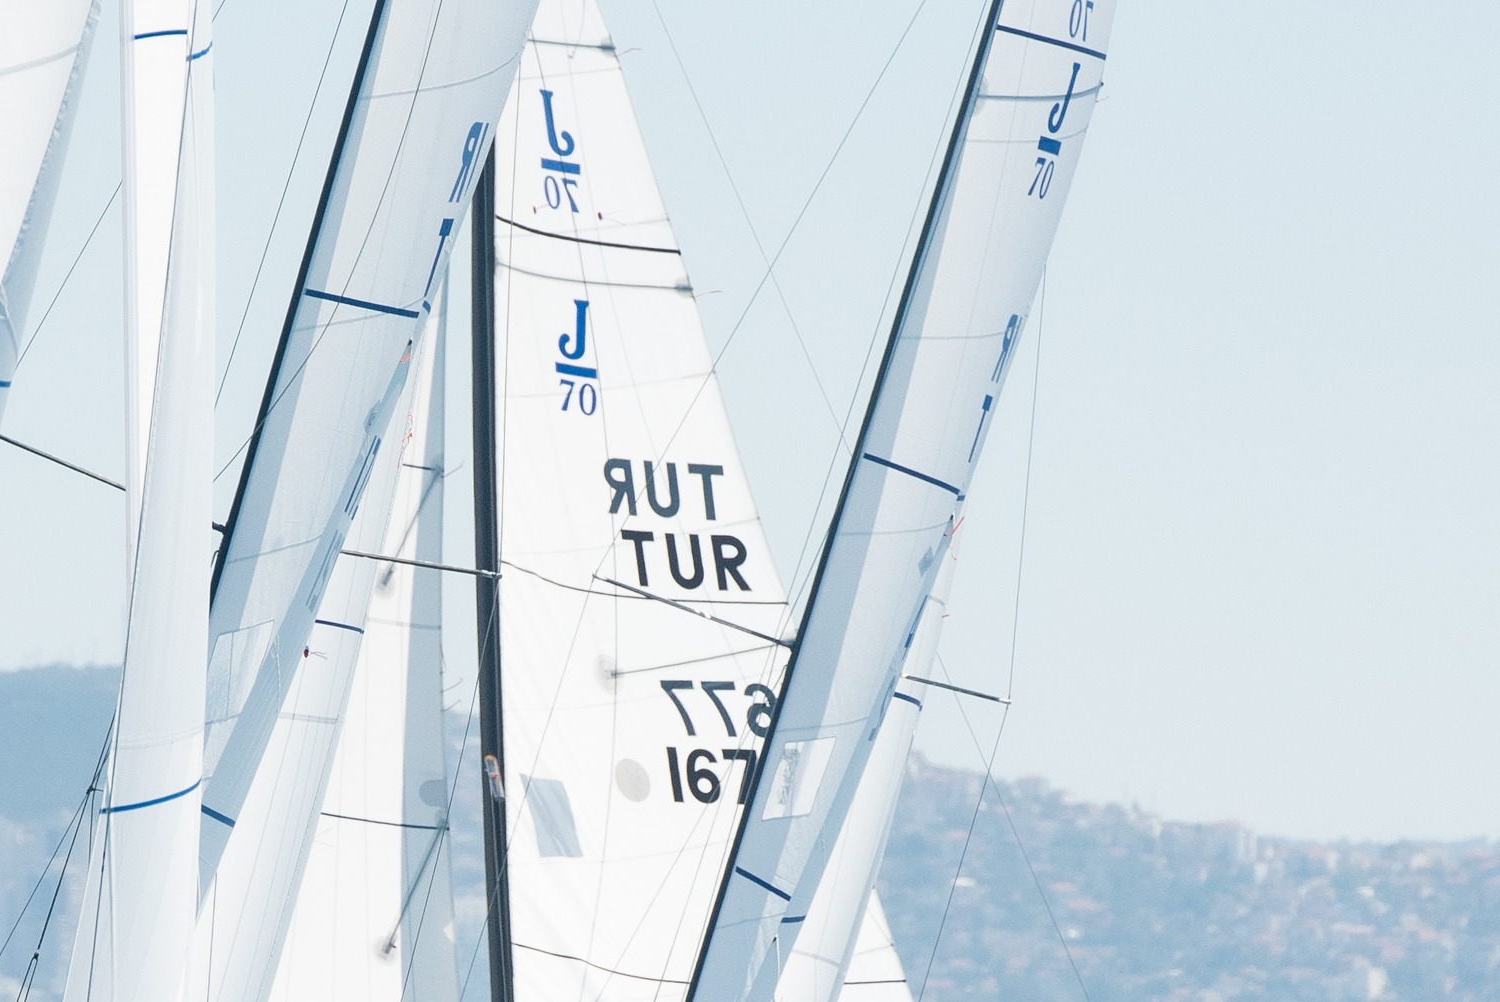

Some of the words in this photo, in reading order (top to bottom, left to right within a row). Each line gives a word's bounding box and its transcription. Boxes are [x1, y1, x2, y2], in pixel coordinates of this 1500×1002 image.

[1048, 62, 1081, 134] J
[1028, 156, 1055, 200] 70
[558, 299, 590, 361] J
[559, 379, 597, 416] 70
[621, 529, 752, 592] TUR
[666, 746, 757, 805] 167
